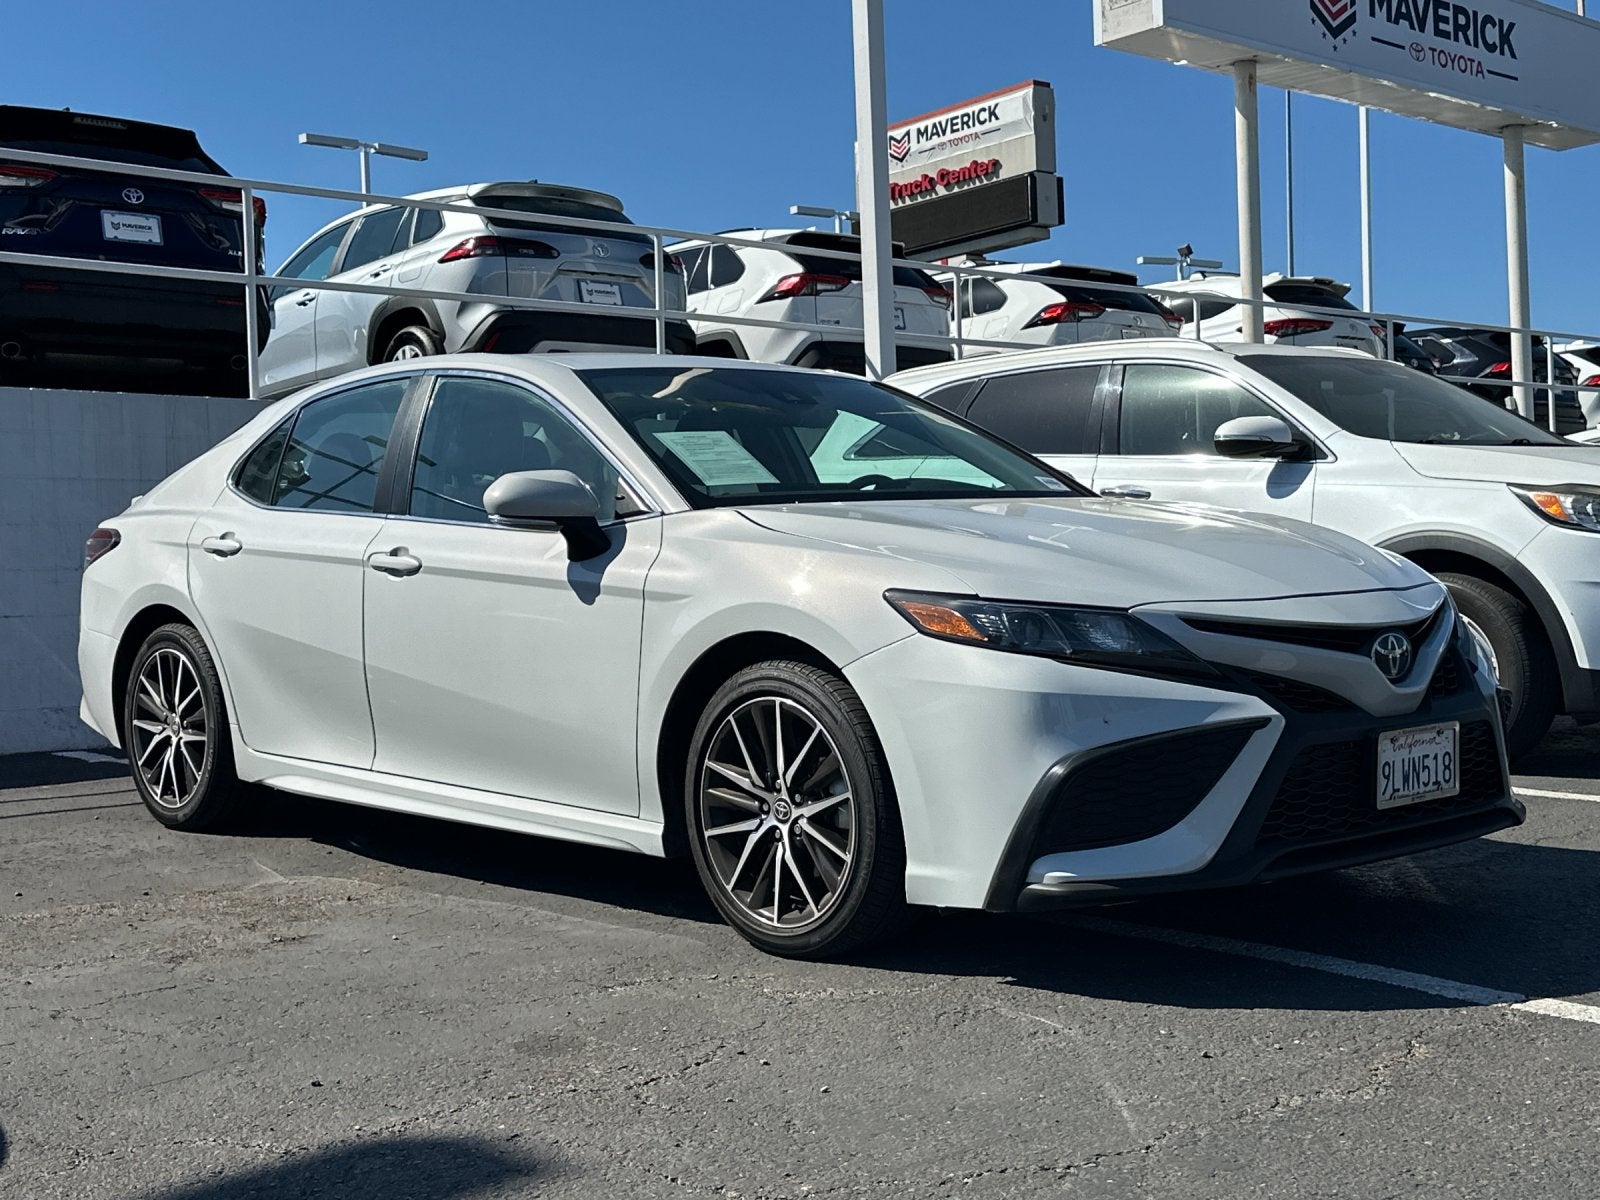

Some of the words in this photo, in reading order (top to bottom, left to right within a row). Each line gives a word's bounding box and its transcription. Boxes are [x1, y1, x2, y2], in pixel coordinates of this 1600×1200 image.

[1428, 46, 1486, 80] TOYOTA
[916, 103, 1000, 144] MAVERICK
[947, 131, 981, 148] TOYOTA
[936, 158, 1001, 187] Center
[121, 222, 153, 231] MAVERICK
[1381, 751, 1453, 796] 9LWN518
